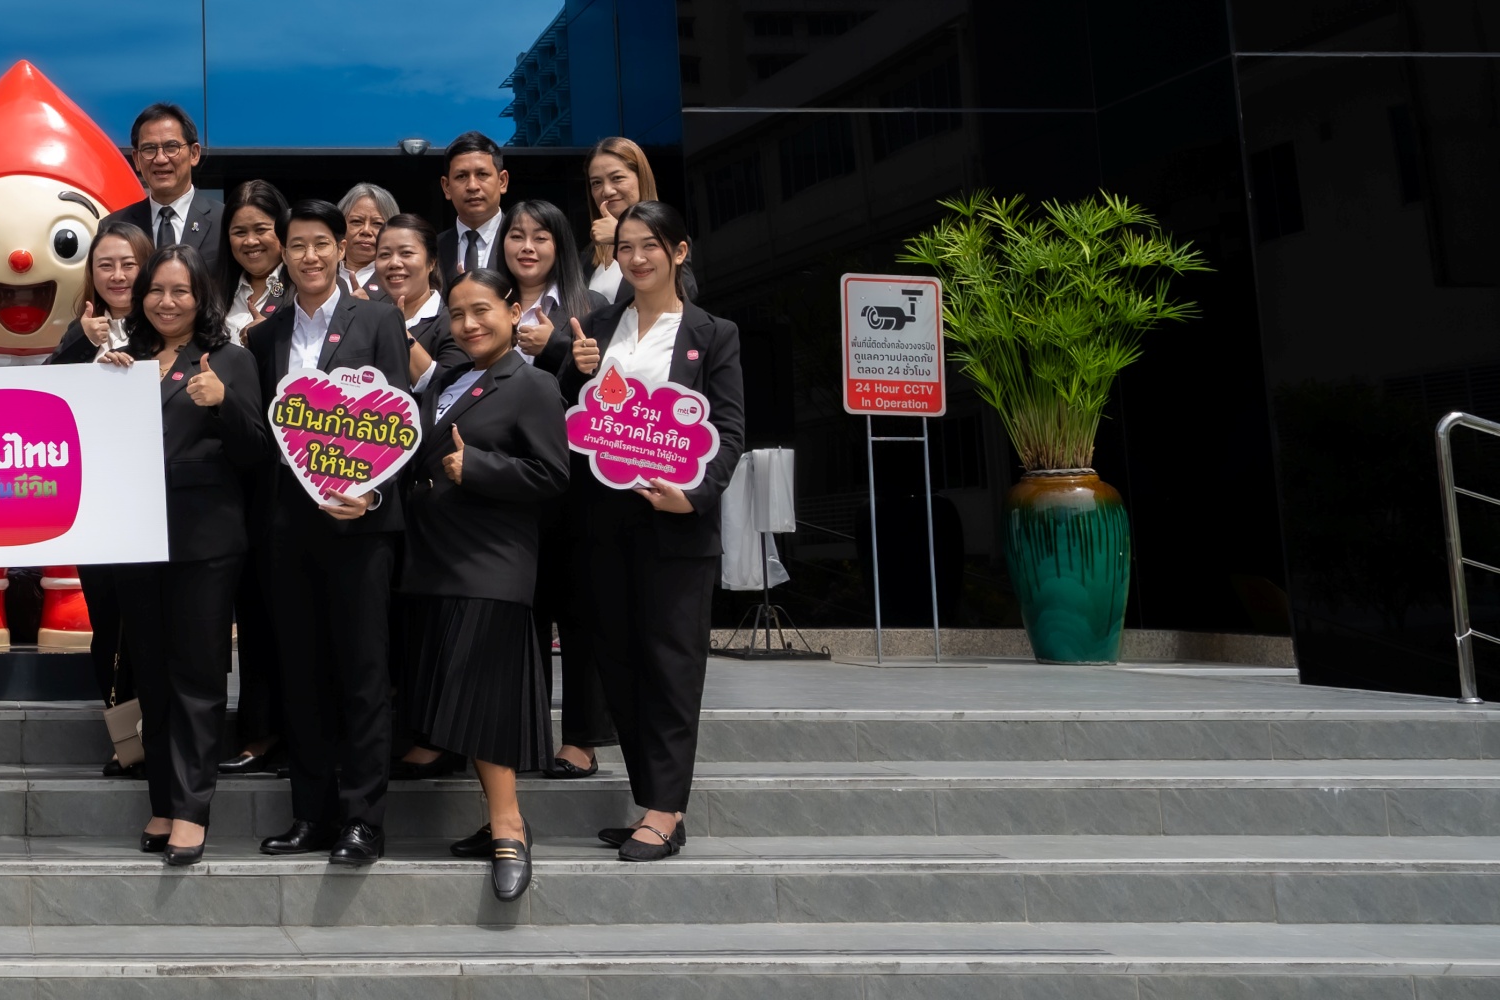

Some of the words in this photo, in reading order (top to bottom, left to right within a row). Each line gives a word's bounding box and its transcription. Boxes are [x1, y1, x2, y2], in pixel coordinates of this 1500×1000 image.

[854, 353, 933, 364] ดูแลความปลอดภัย
[857, 366, 885, 375] ตลอด
[887, 365, 900, 375] 24
[903, 363, 931, 376] ชั่วโมง
[341, 373, 361, 385] mtl
[855, 383, 870, 393] 24
[875, 384, 900, 394] Hour
[904, 385, 933, 395] CCTV
[861, 397, 871, 407] In
[875, 398, 928, 409] Operation
[632, 401, 661, 422] ร่วม
[275, 396, 415, 448] เป็นกำลังใจ
[590, 415, 691, 451] บริจาคโลหิต
[309, 442, 370, 480] ให้นะ
